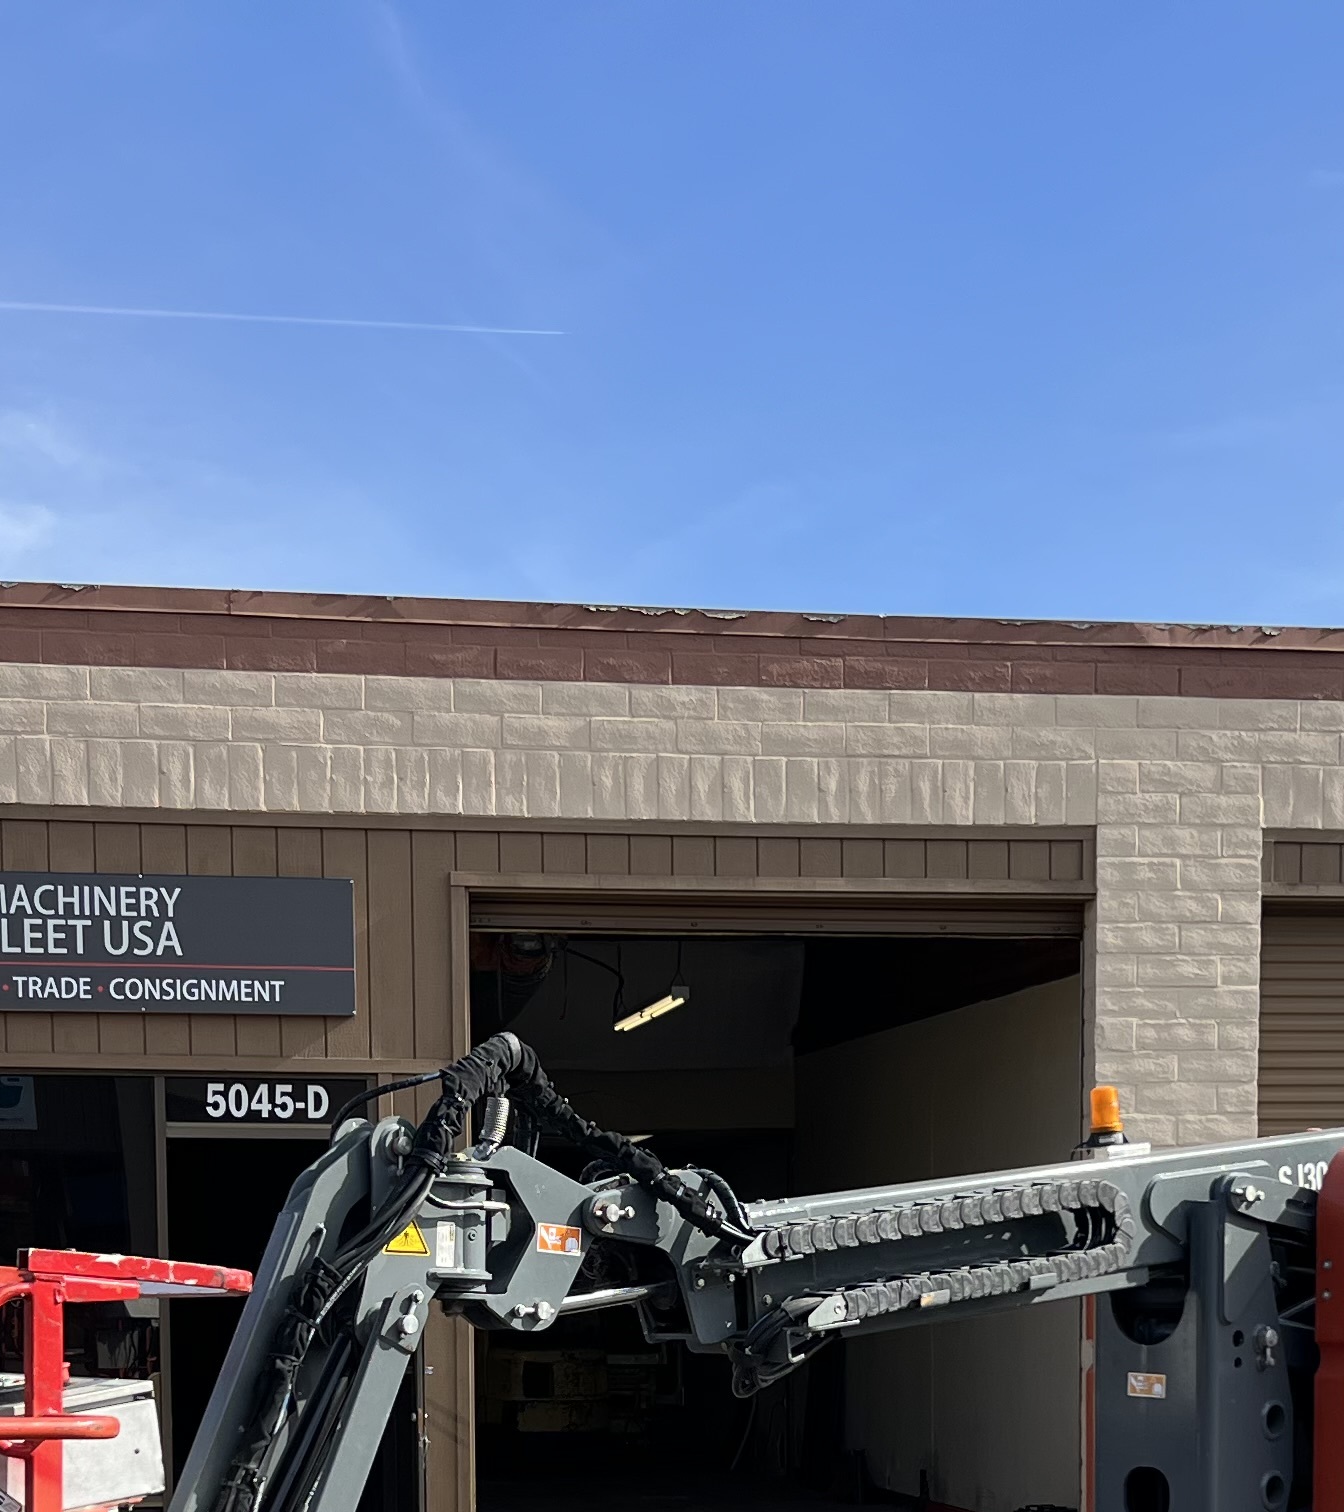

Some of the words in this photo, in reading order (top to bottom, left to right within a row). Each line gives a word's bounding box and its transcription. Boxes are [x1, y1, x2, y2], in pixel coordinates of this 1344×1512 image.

[103, 919, 184, 957] USA
[12, 976, 92, 999] TRADE
[109, 977, 285, 1002] CONSIGNMENT
[206, 1083, 329, 1118] 5045-D
